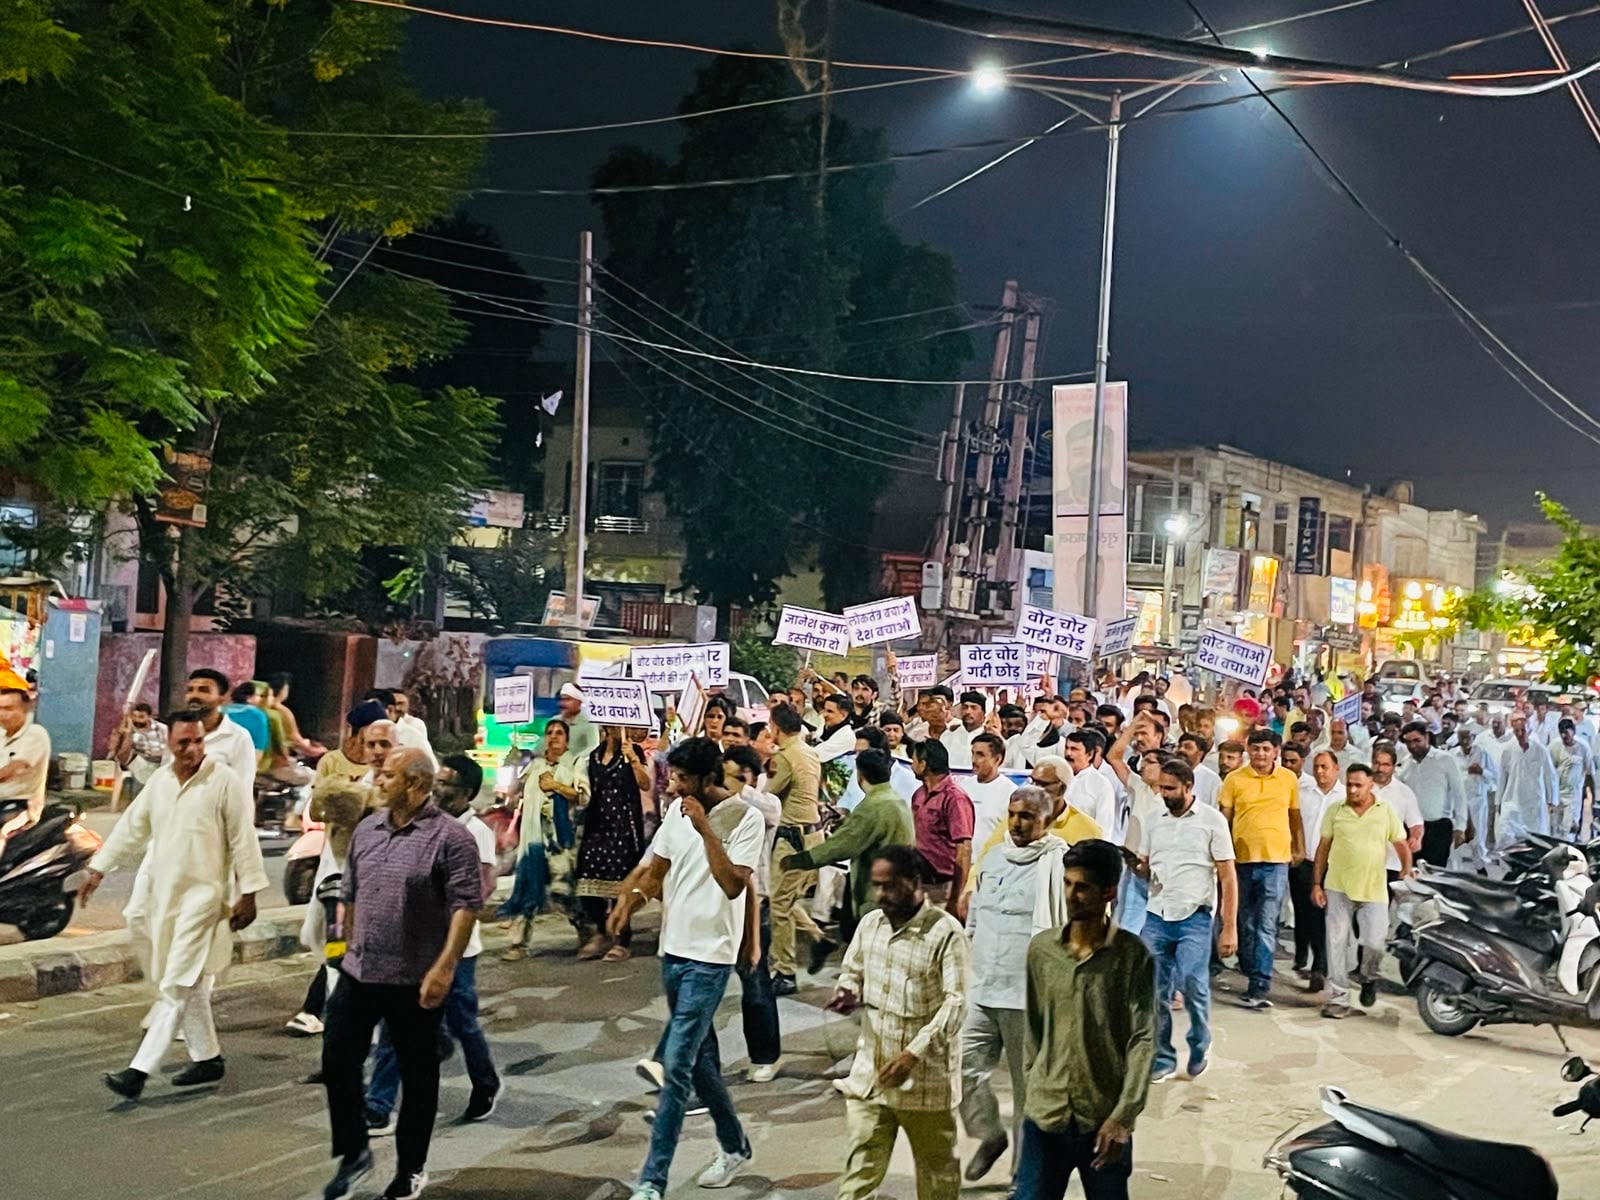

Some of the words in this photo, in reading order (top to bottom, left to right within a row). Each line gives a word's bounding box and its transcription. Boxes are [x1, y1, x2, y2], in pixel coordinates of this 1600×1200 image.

[1028, 609, 1056, 626] वोट
[1060, 616, 1088, 634] चोर
[856, 628, 874, 642] देश
[1022, 626, 1052, 643] गद्दी
[1055, 633, 1085, 654] छोड़
[1202, 634, 1225, 648] वोट
[828, 637, 840, 651] दो
[968, 646, 992, 660] वोट
[995, 646, 1019, 660] चोर
[1199, 648, 1219, 665] देश
[967, 663, 992, 678] गद्दी
[995, 663, 1020, 681] छोड़
[589, 701, 606, 716] देश
